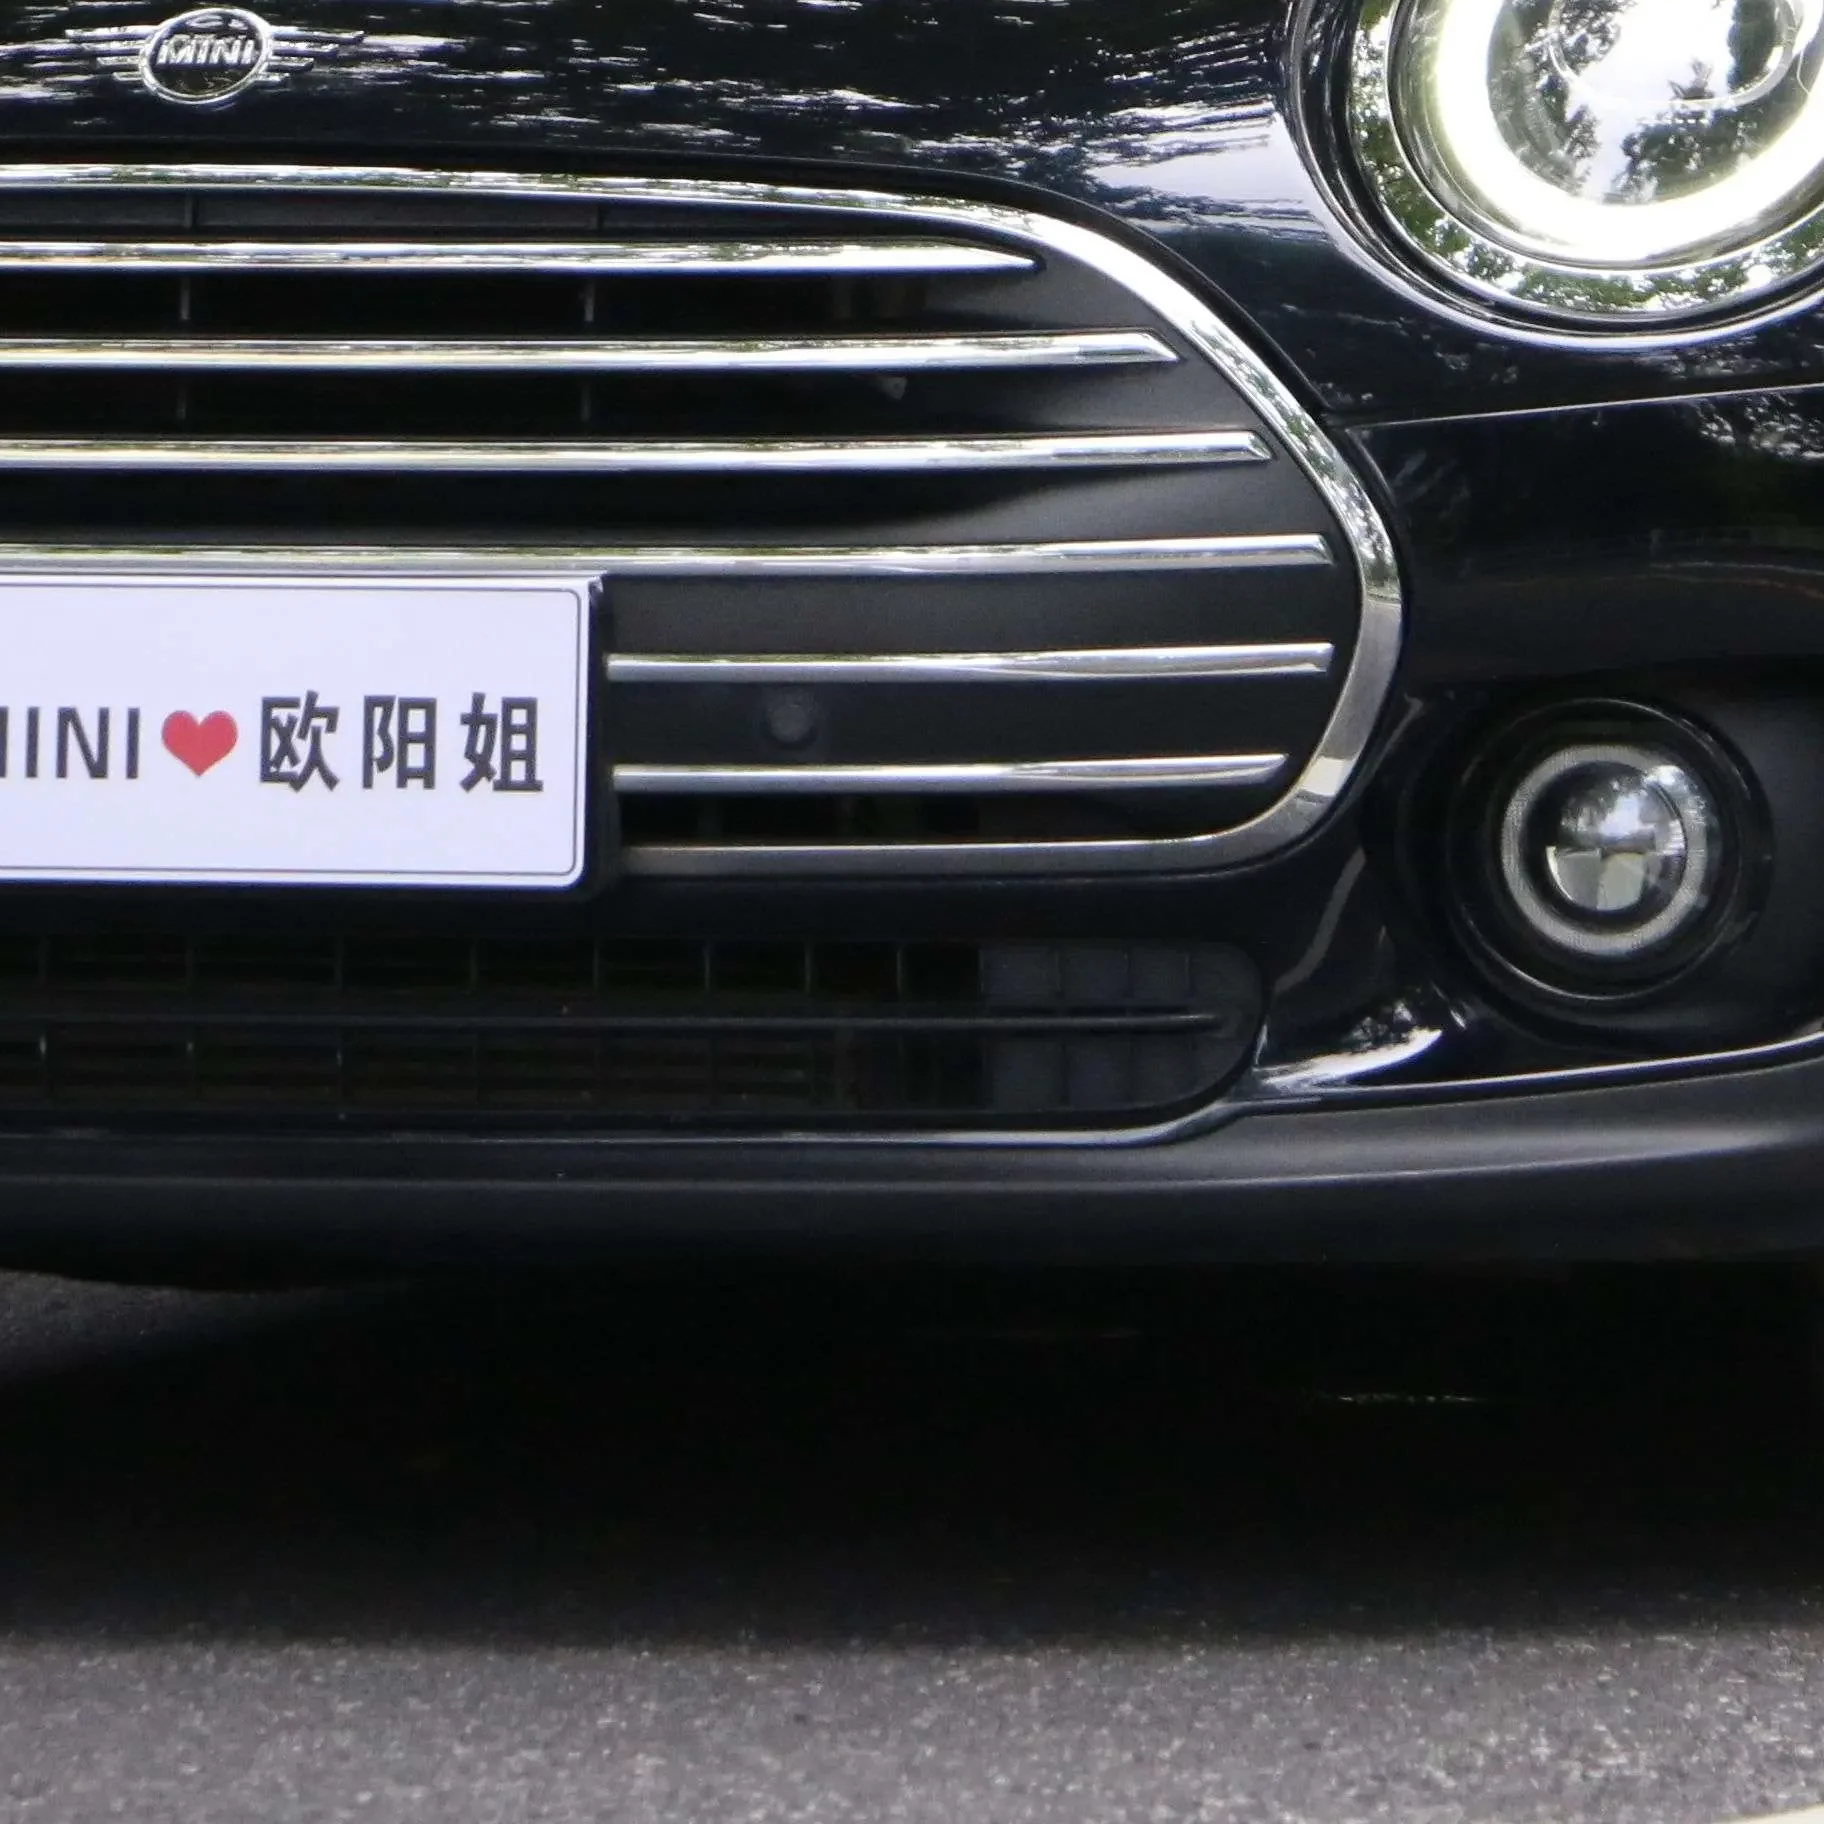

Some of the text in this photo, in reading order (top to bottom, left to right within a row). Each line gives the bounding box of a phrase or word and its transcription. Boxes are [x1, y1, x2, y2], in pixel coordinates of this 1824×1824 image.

[157, 38, 256, 65] MINI
[259, 690, 544, 794] 欧阳姐
